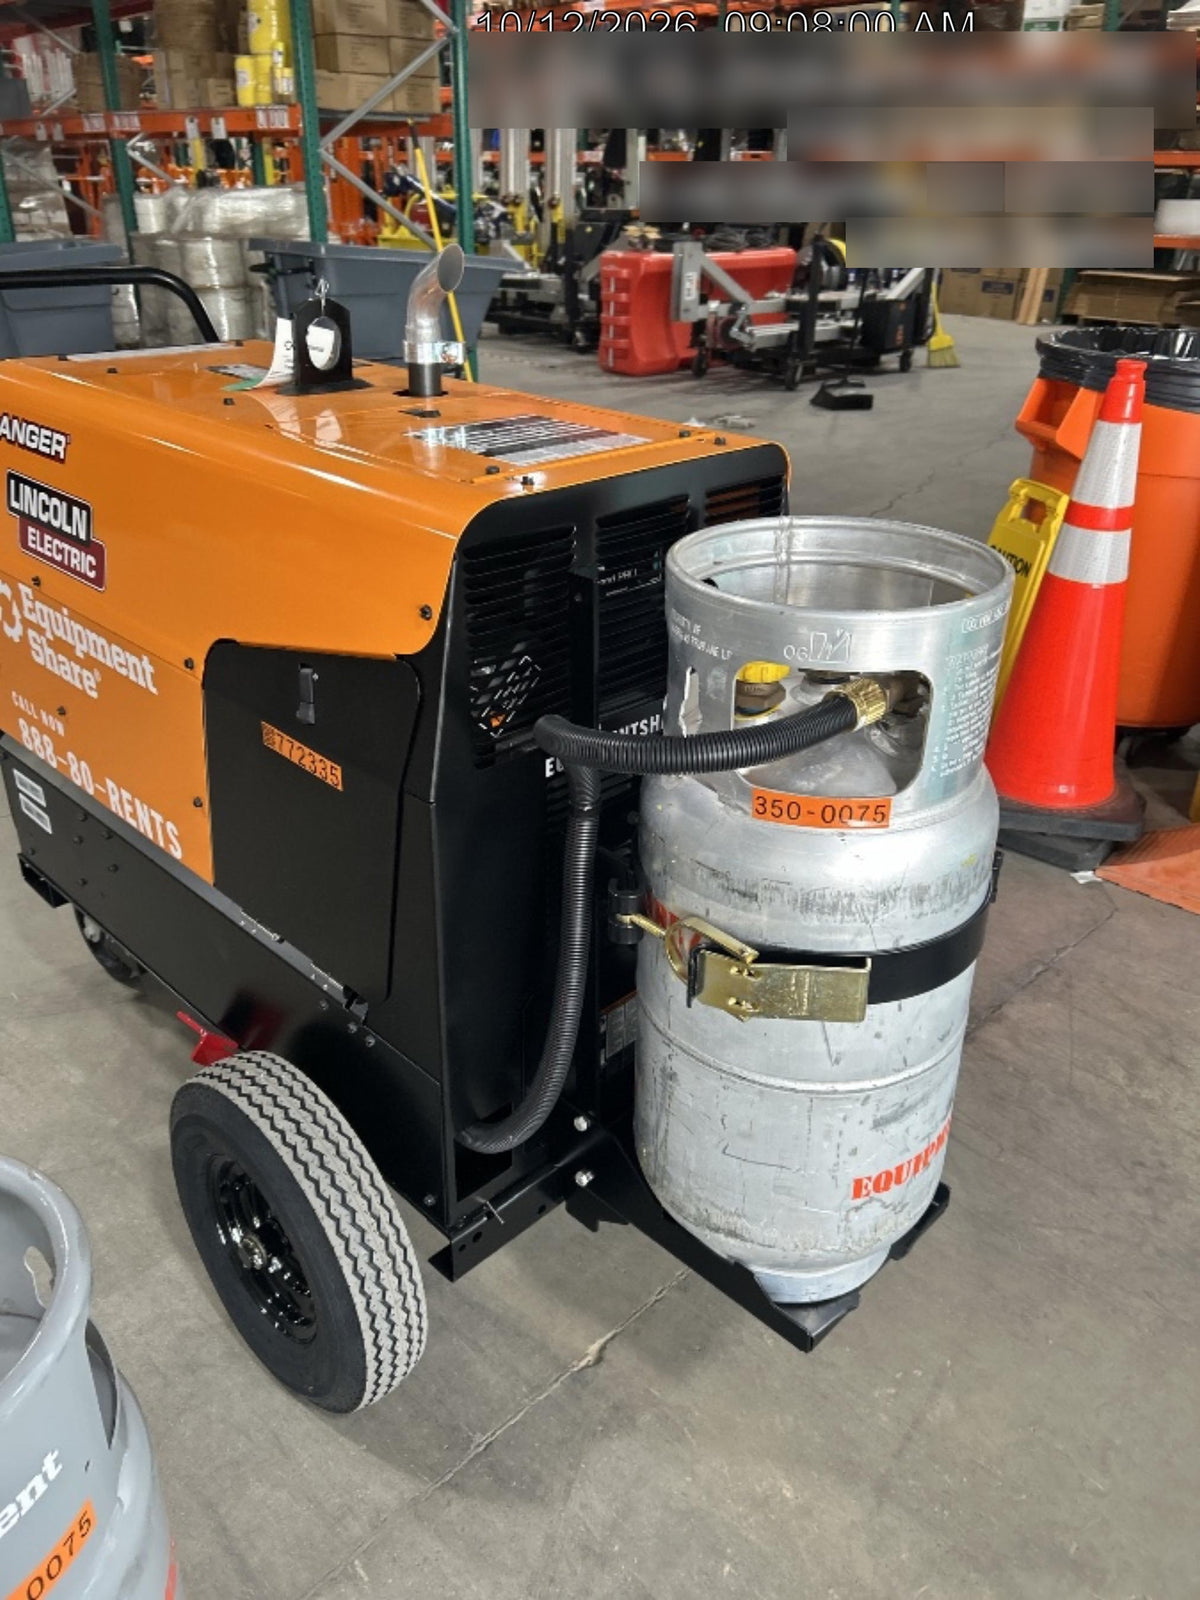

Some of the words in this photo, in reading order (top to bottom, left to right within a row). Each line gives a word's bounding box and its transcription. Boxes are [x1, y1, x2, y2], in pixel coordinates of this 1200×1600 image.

[9, 479, 88, 541] LINCOLN
[27, 525, 97, 579] ELECTRIC
[18, 582, 159, 695] Equipment
[275, 731, 340, 787] 772335
[18, 717, 183, 861] 888-80-RENTS
[754, 795, 887, 824] 350-0075
